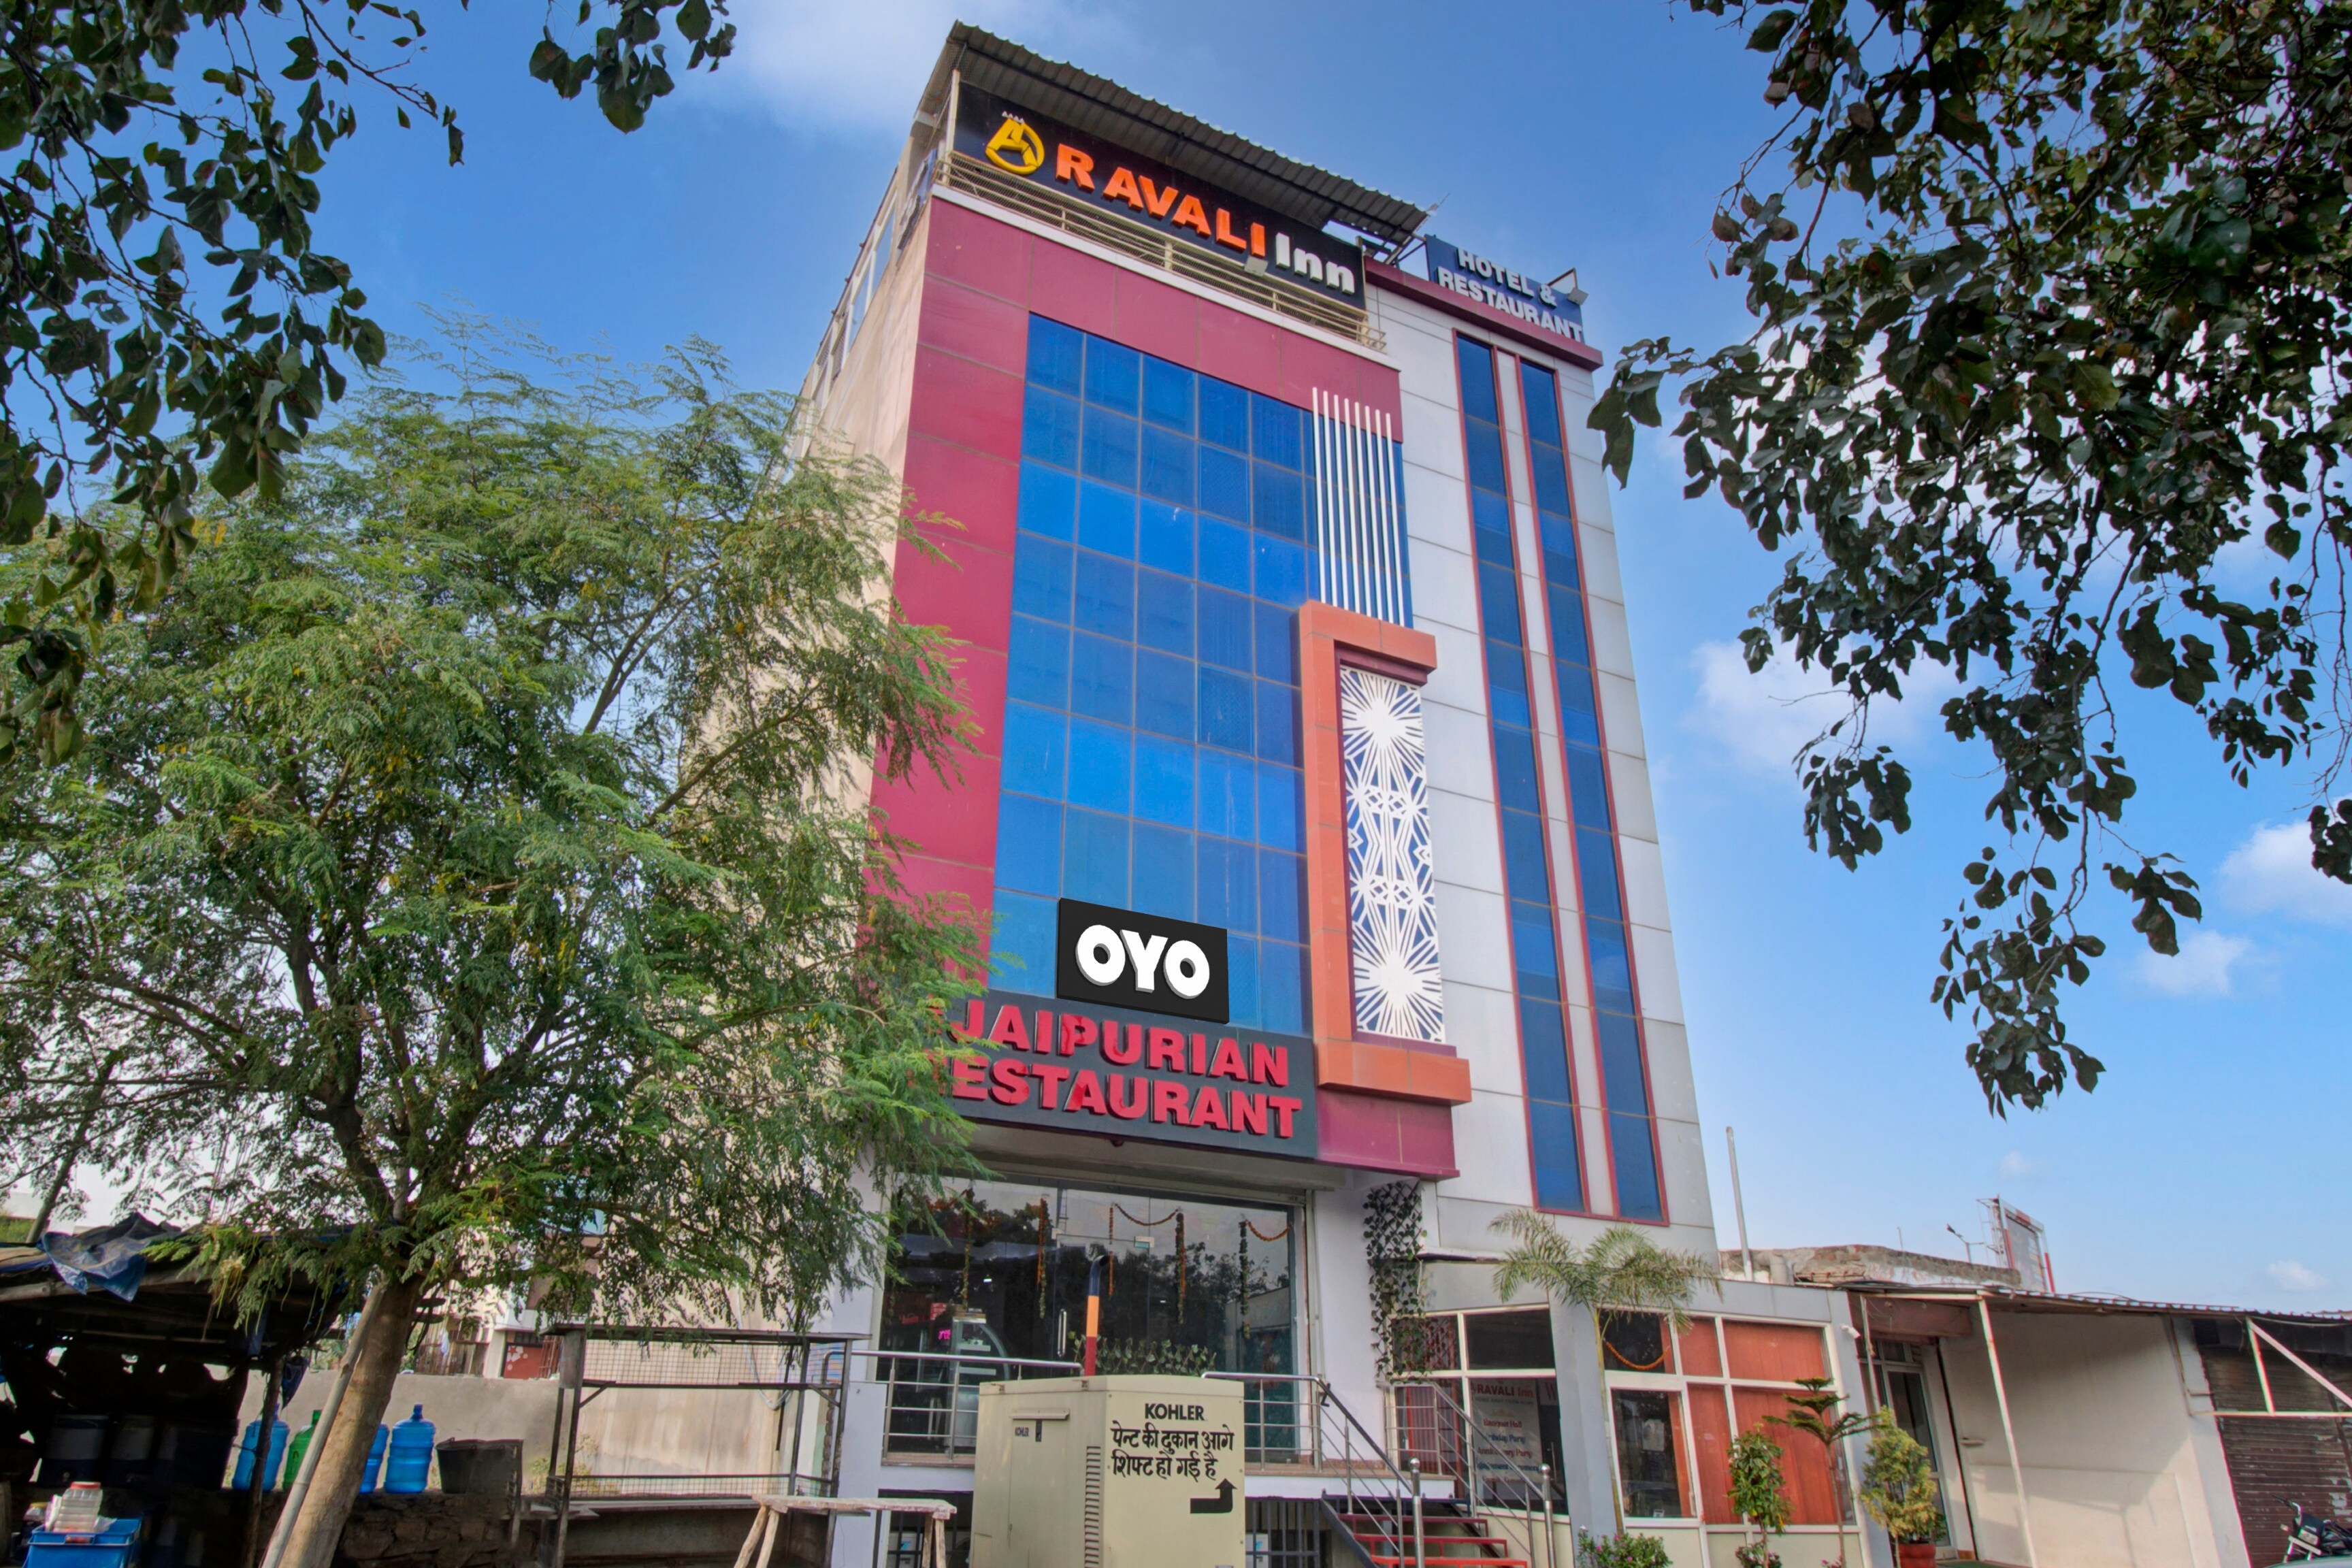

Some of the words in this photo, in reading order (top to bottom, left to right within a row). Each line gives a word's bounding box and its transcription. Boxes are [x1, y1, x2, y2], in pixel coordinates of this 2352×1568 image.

[1275, 232, 1356, 296] Inn
[1456, 248, 1535, 298] HOTEL
[1538, 283, 1558, 308] &
[1437, 266, 1582, 341] RESTAURANT
[1075, 924, 1211, 1000] OYO
[947, 999, 1289, 1088] JAIPURIAN
[1111, 1420, 1141, 1448] पेन्ट
[1142, 1422, 1159, 1448] की
[1161, 1430, 1198, 1455] दुकान
[1201, 1424, 1235, 1451] आगे
[1145, 1403, 1205, 1422] KOHLER
[1111, 1449, 1154, 1478] शिफ्ट
[1156, 1450, 1173, 1480] हो
[1175, 1450, 1200, 1483] गई
[1204, 1450, 1218, 1481] है
